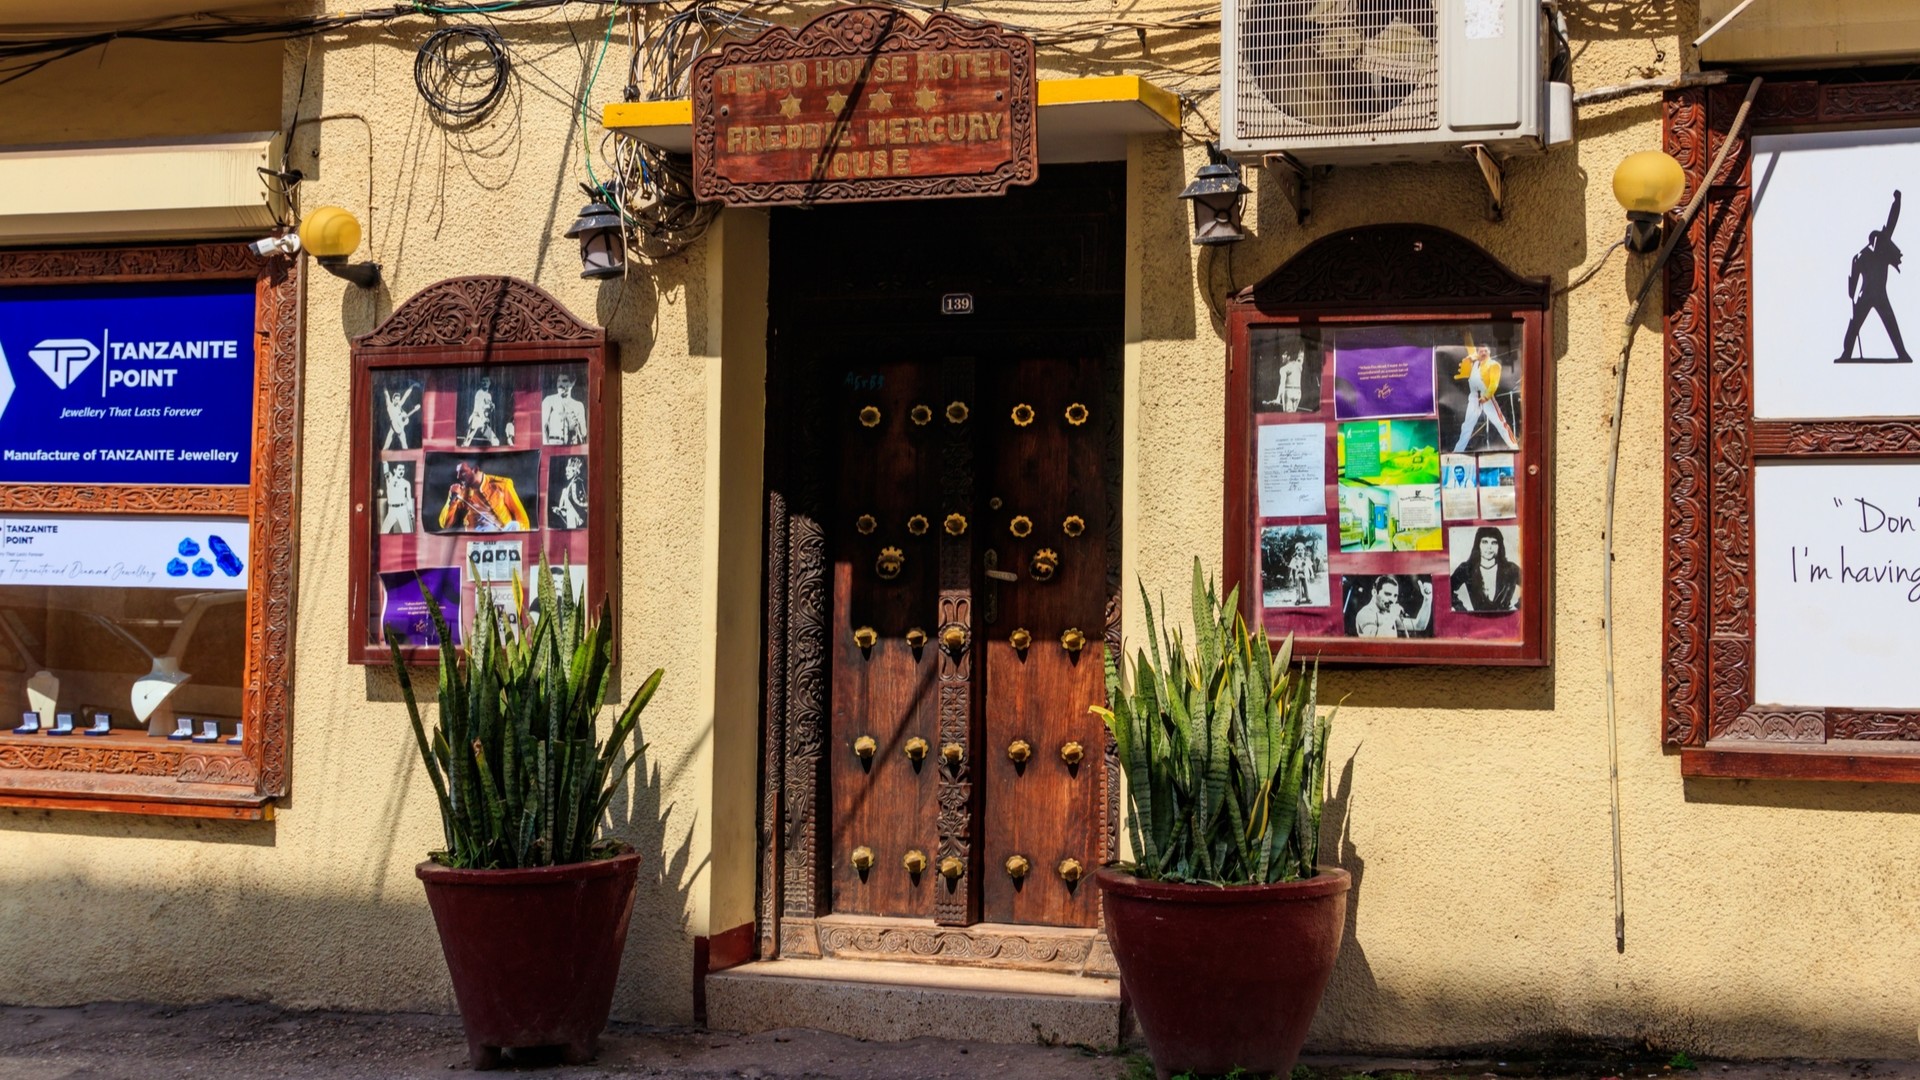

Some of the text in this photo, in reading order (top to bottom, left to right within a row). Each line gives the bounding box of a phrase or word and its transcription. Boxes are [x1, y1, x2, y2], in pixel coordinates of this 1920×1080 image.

[719, 52, 1010, 95] TEMBO HOUSE HOTEL
[727, 112, 1003, 153] FREDDIE MERCURY
[811, 149, 911, 178] HOUSE
[946, 298, 970, 311] 139
[110, 340, 238, 360] TANZANITE
[109, 369, 178, 388] POINT
[59, 406, 203, 419] Jewellery That Lasts Forever
[4, 449, 239, 463] Manufacture of TANZANITE Jewellery
[6, 525, 58, 534] TANZANITE
[6, 536, 34, 545] POINT
[1792, 546, 1833, 583] I'm
